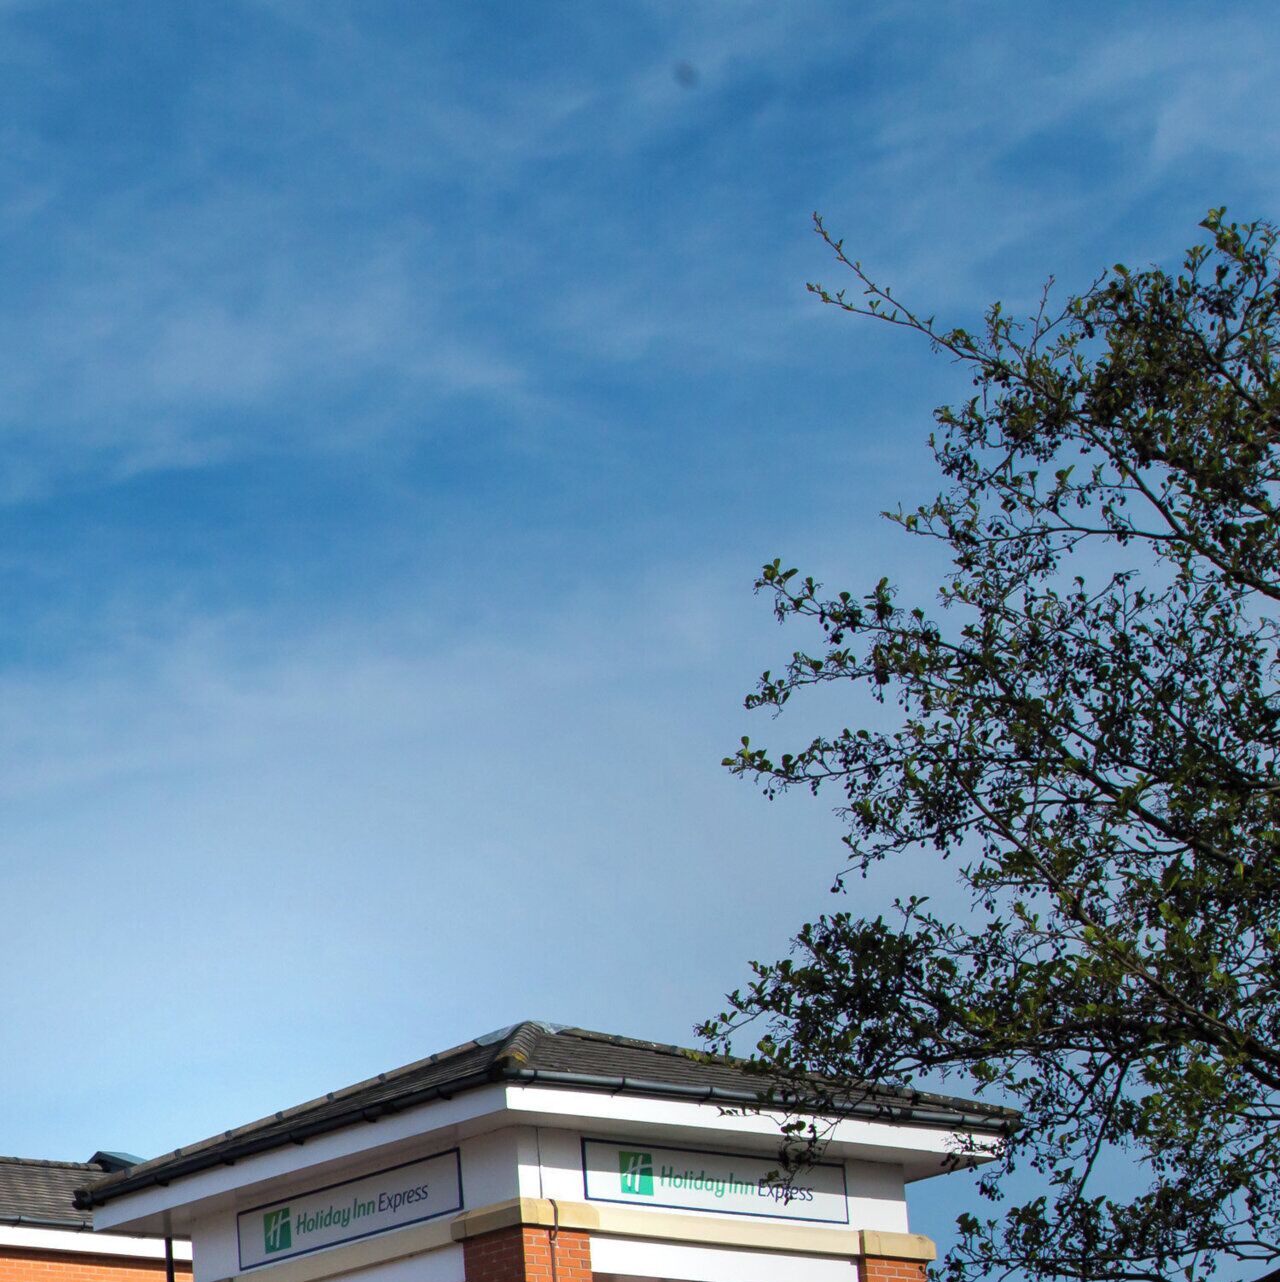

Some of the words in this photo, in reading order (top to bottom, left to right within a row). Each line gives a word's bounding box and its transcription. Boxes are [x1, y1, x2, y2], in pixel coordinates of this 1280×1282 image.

[659, 1165, 725, 1198] Holiday
[729, 1172, 755, 1195] Inn
[295, 1206, 351, 1235] Holiday
[353, 1198, 376, 1219] Inn
[378, 1185, 429, 1213] Express
